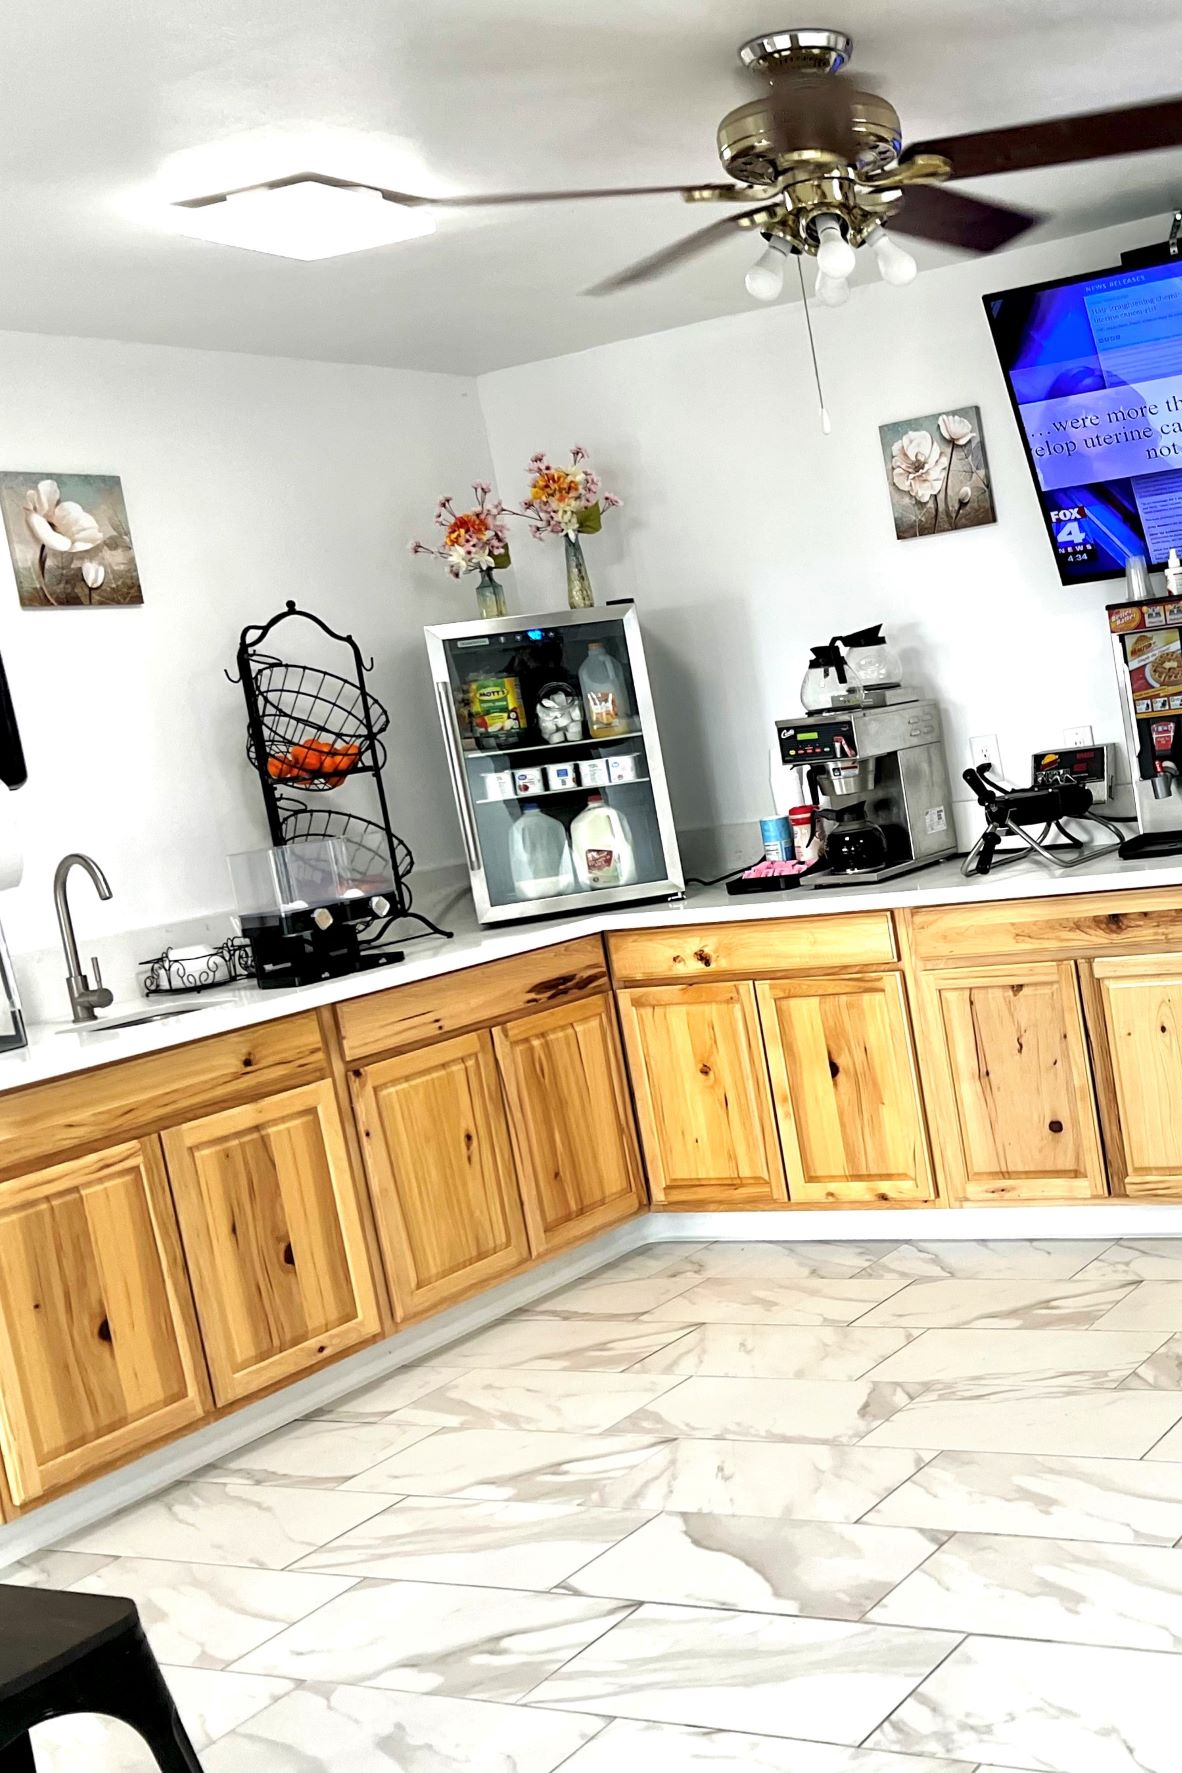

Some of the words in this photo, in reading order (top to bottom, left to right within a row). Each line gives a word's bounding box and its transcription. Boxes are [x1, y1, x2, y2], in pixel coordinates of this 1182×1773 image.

[1107, 402, 1159, 424] more
[1084, 426, 1153, 449] uterine
[1146, 441, 1179, 460] not
[1050, 508, 1081, 522] FOX
[1057, 521, 1085, 543] 4
[1058, 544, 1092, 553] NEWS
